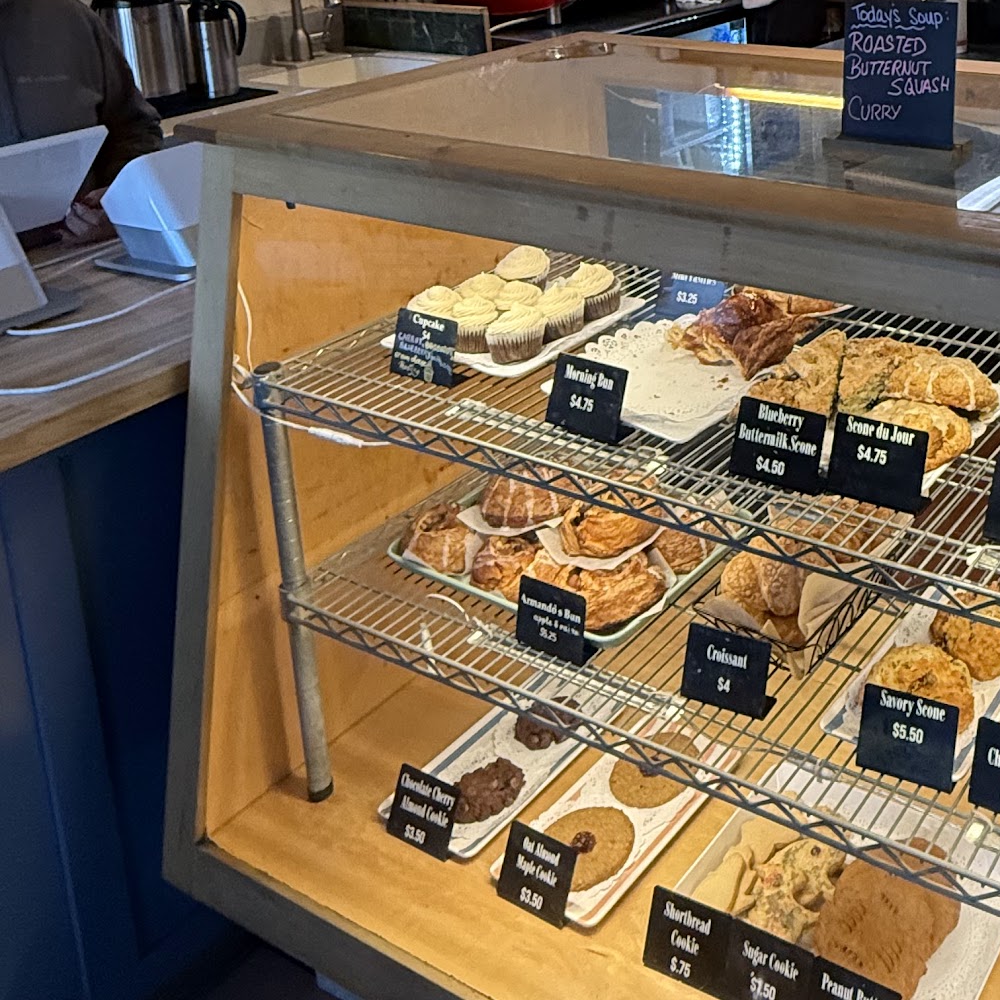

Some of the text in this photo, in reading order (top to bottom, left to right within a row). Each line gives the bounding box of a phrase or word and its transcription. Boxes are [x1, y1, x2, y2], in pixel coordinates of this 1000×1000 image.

[850, 2, 901, 28] Today's
[848, 31, 927, 57] ROASTED
[845, 53, 932, 80] BUTTERNUT
[887, 75, 950, 97] SQUASH
[847, 95, 902, 121] CURRY
[676, 290, 698, 305] $3.25
[412, 313, 445, 332] Cupcake
[563, 363, 614, 391] Morning Bun
[569, 393, 594, 413] $4.75
[757, 403, 805, 433] Blueberry
[846, 415, 915, 447] Scone du Jour
[738, 423, 818, 457] Buttermilk Scone
[755, 455, 786, 477] $4.50
[856, 443, 888, 466] $4.75
[563, 608, 581, 625] Bun
[706, 643, 748, 671] Croissant
[716, 676, 731, 694] $4
[879, 688, 946, 722] Savory Scone
[891, 721, 924, 745] $5.50
[401, 772, 456, 812] Chocolate Cherry
[400, 794, 449, 829] Almond Cookie
[404, 823, 426, 845] $3.50
[522, 835, 561, 867] Oat Almond
[516, 853, 558, 888] Maple Cookie
[520, 886, 544, 911] $3.50
[663, 900, 712, 936] Shortbread
[670, 929, 700, 956] Cookie
[669, 956, 692, 979] $.75
[742, 939, 799, 982] Sugar Cookie
[821, 971, 855, 1000] Peanut
